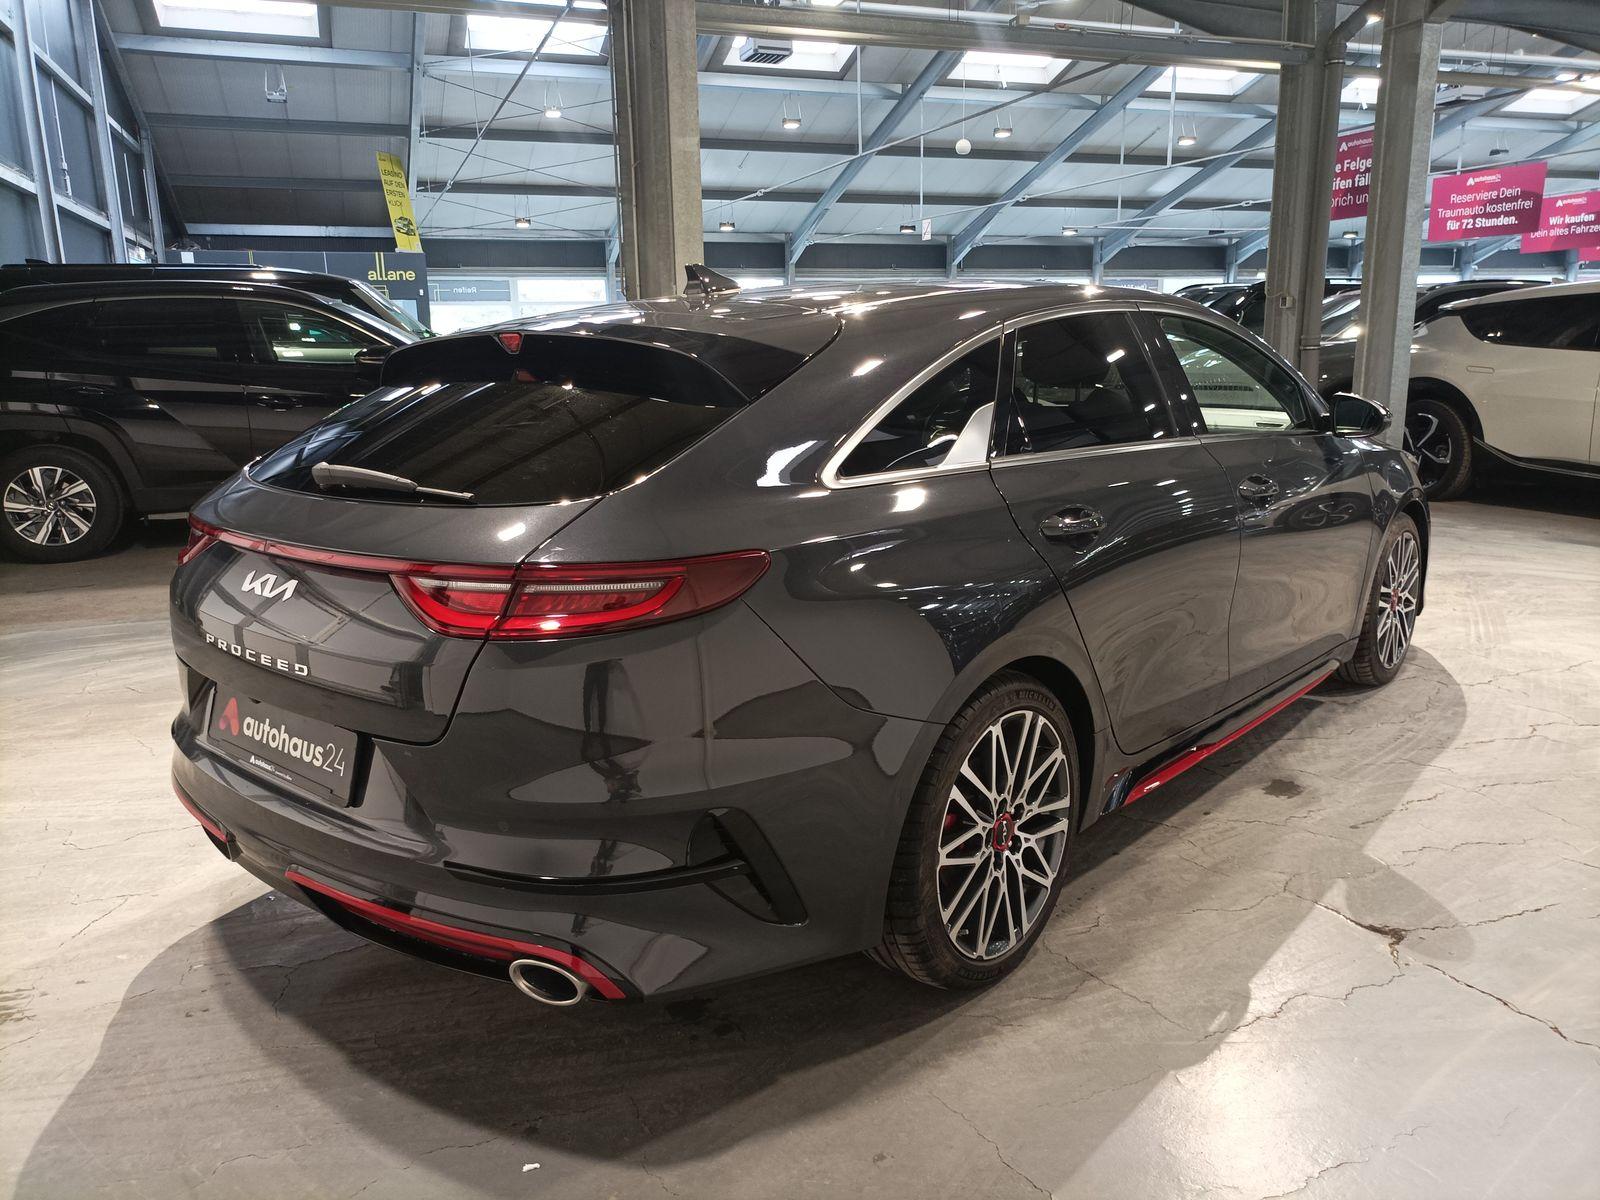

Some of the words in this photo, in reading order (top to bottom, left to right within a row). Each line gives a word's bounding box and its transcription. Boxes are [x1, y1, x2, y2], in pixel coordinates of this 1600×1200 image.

[1343, 157, 1373, 172] Felge
[1450, 189, 1498, 204] Reserviere
[1499, 185, 1521, 198] Dein
[1437, 205, 1485, 218] Traumauto
[1486, 197, 1534, 213] kostenfrei
[1446, 219, 1460, 231] für
[1461, 218, 1474, 229] 72
[1475, 215, 1518, 228] Stunden.
[1549, 215, 1564, 226] Wir
[1564, 213, 1595, 224] kaufen
[1549, 227, 1569, 237] altes
[367, 251, 416, 281] allane
[241, 569, 299, 602] KIA
[206, 633, 308, 676] PROCEED
[243, 716, 345, 777] autohaus24
